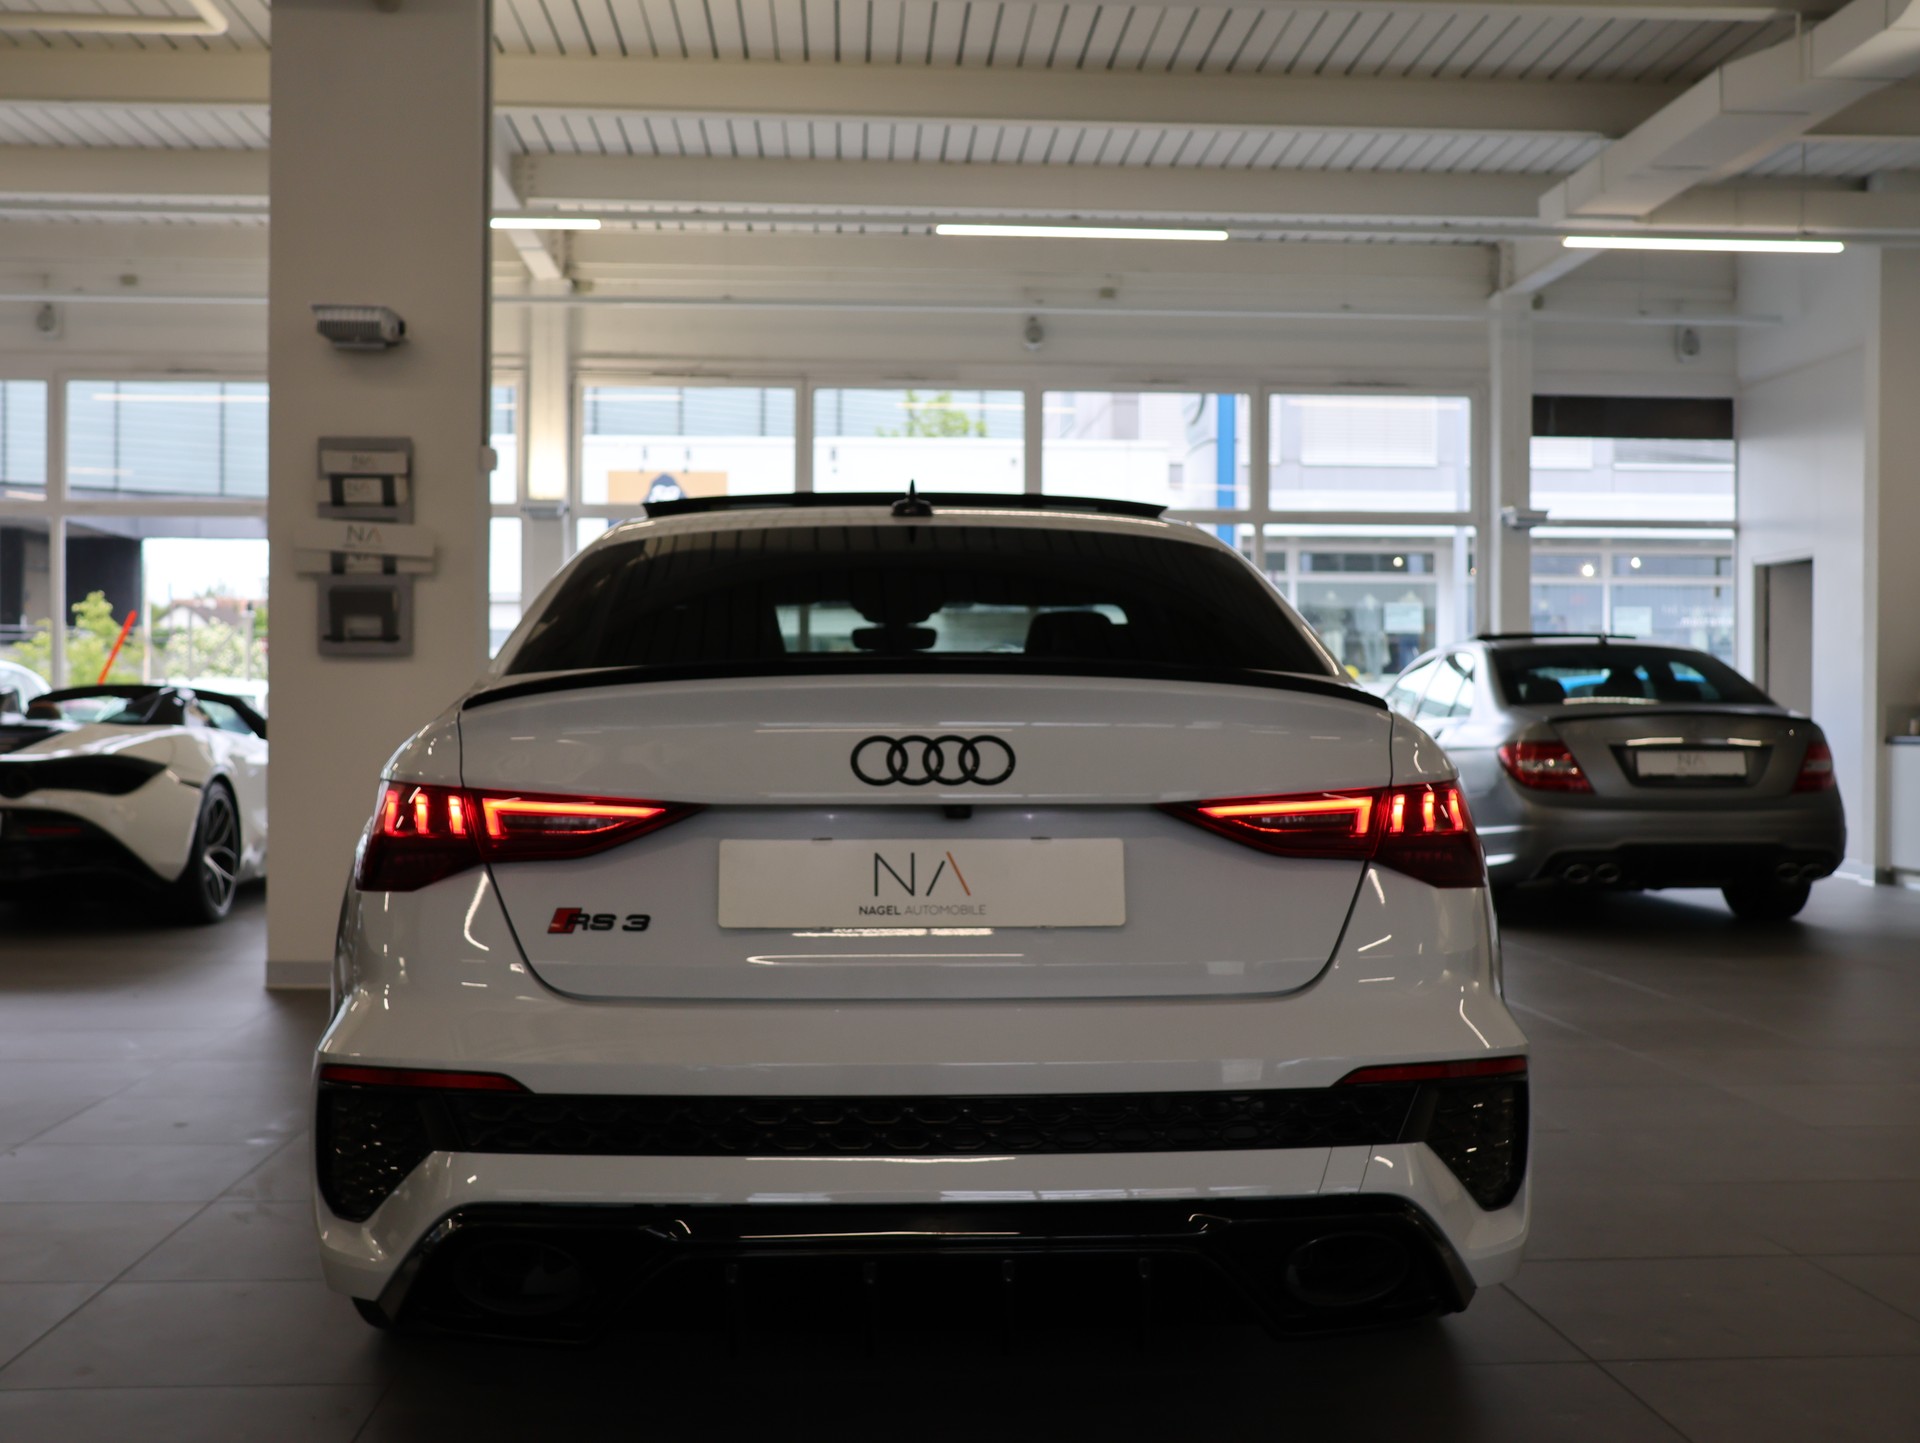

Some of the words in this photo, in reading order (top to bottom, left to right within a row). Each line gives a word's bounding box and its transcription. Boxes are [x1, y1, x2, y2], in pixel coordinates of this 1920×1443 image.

[874, 851, 971, 897] NA
[858, 905, 901, 916] NAGEL
[904, 904, 987, 916] AUTOMOBILE
[564, 913, 617, 931] RS
[622, 914, 651, 932] 3
